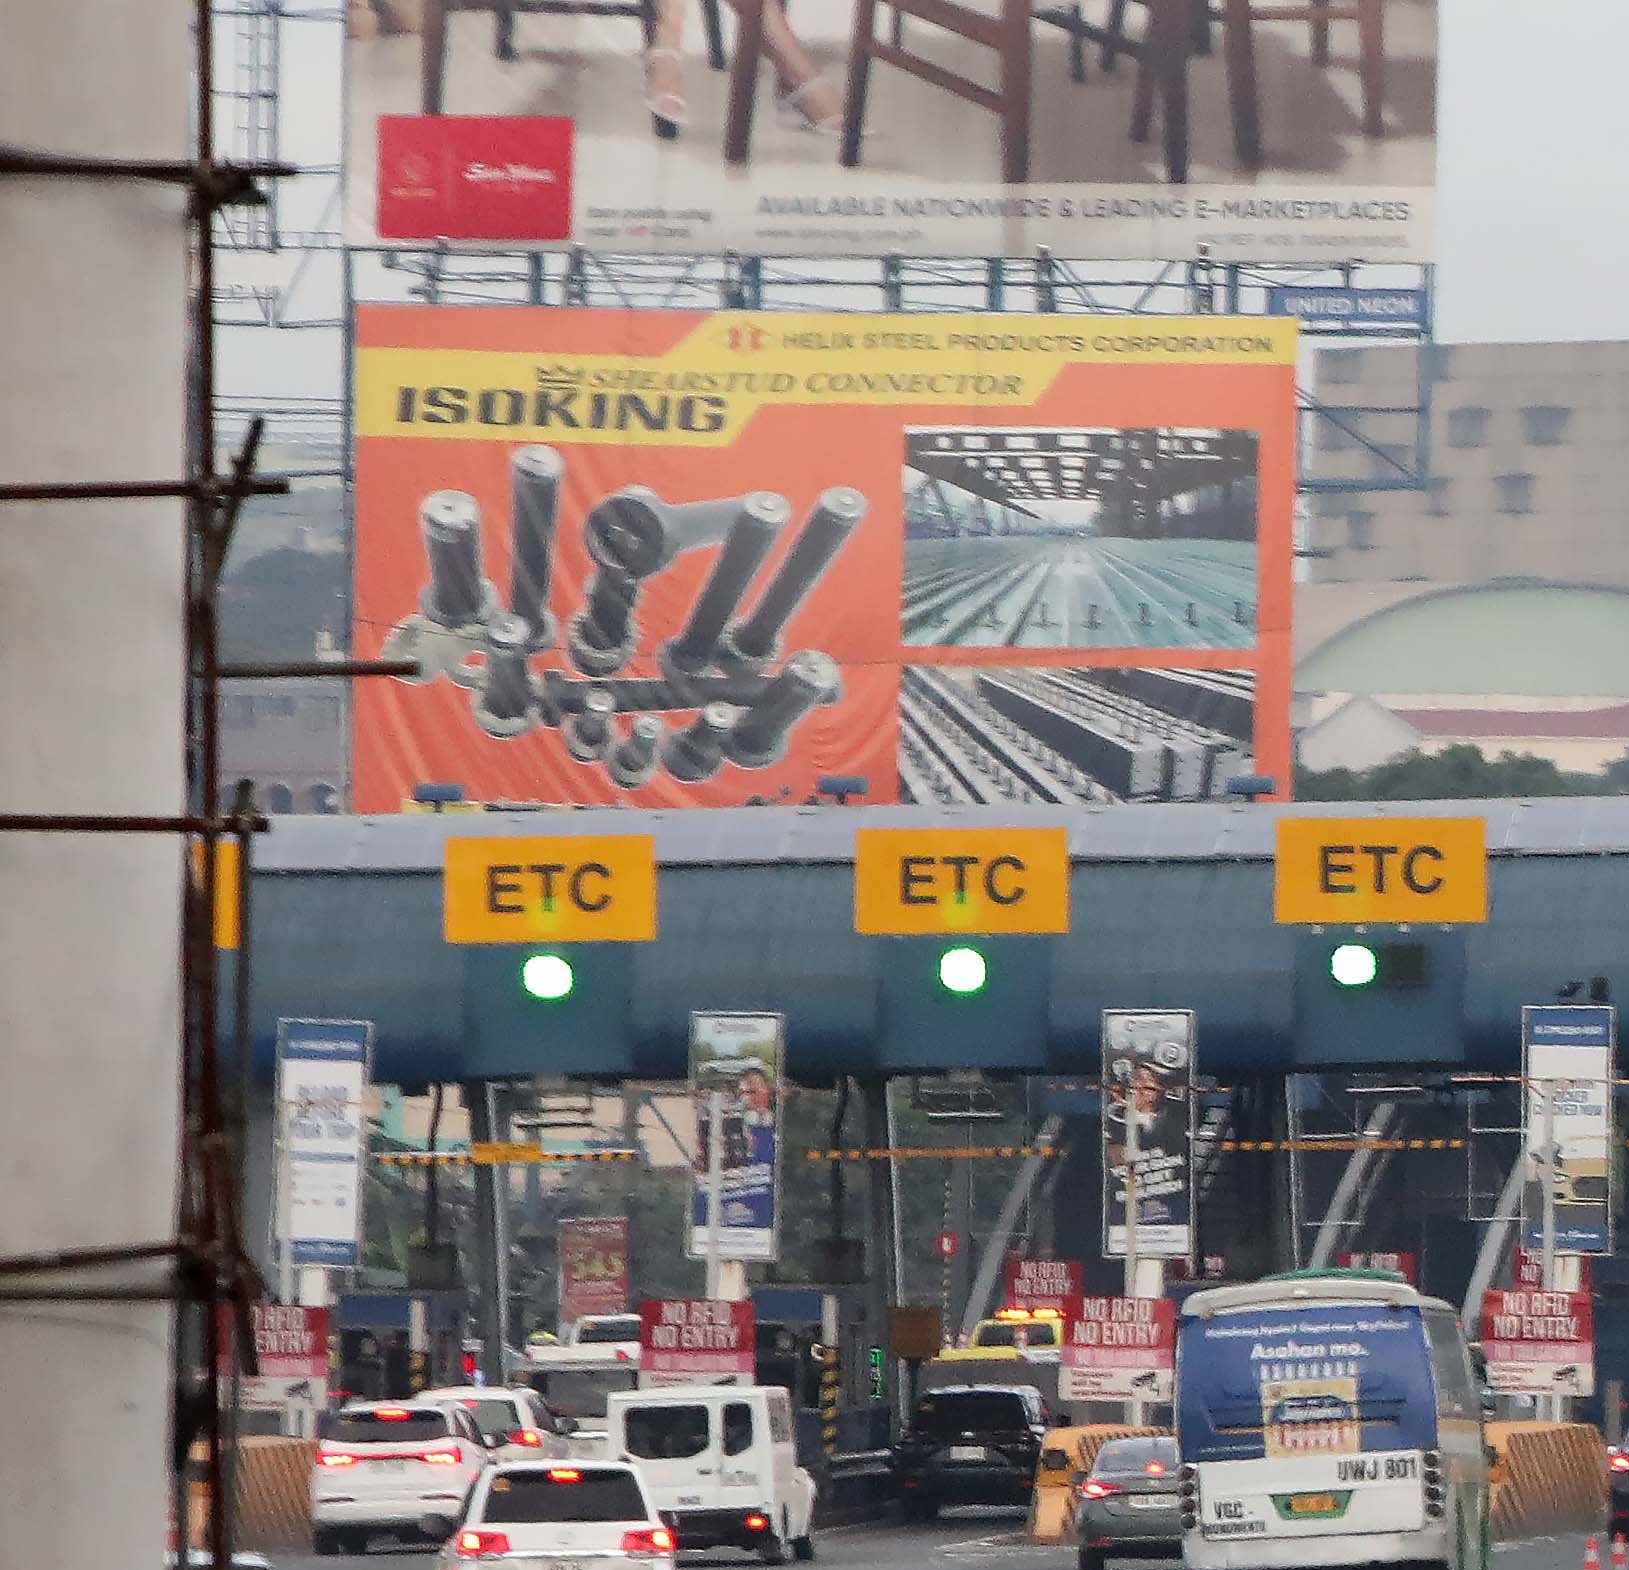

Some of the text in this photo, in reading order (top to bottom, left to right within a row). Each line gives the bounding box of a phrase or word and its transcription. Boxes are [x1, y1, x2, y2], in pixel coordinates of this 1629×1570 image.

[757, 196, 886, 217] AVAILABLE
[1083, 198, 1188, 218] LEADING
[1198, 200, 1409, 221] E-MARKETPLACES
[1284, 298, 1419, 315] UNITED NEON
[783, 333, 1274, 353] HELIX STEEL PRODUCTS CORPORATION
[590, 367, 1025, 396] SHEARSTUD CONNECTOR
[396, 385, 730, 432] ISOKING
[901, 857, 1026, 905] ETC
[1319, 846, 1444, 894] ETC
[488, 863, 612, 914] ETC
[661, 1301, 687, 1324] NO
[1083, 1298, 1154, 1322] NO RFID
[1503, 1293, 1570, 1316] NO RFID
[651, 1325, 739, 1349] NO ENTRY
[1072, 1321, 1162, 1346] NO ENTRY
[1493, 1315, 1580, 1340] NO ENTRY
[1251, 1341, 1326, 1359] Asahan
[1337, 1460, 1378, 1481] UWJ
